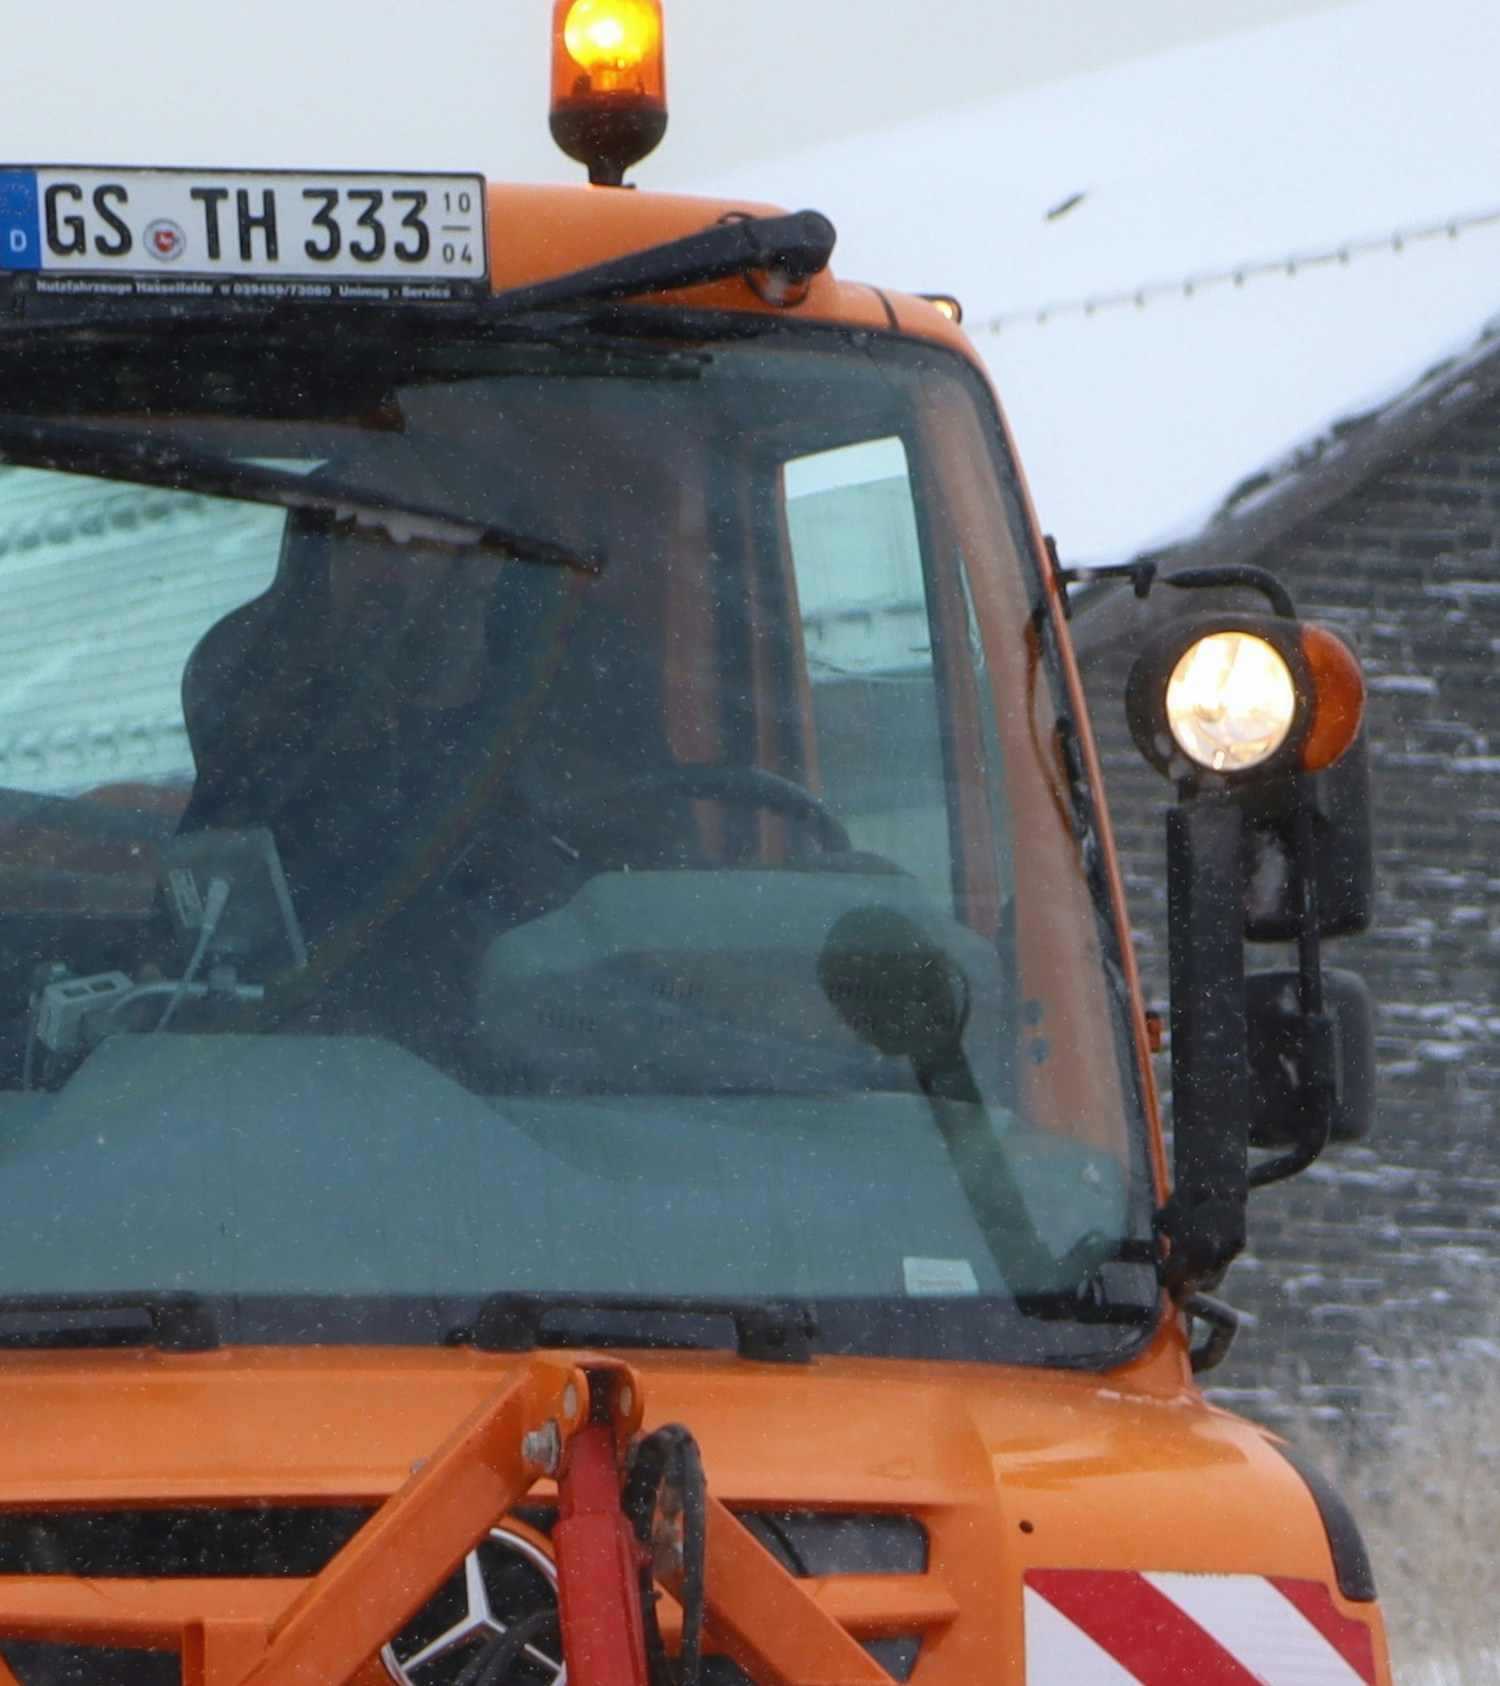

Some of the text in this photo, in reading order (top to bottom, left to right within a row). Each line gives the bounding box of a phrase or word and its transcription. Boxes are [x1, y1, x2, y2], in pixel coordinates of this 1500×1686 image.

[443, 191, 471, 213] 10
[44, 183, 430, 263] GS TH 333
[10, 229, 27, 251] D
[442, 242, 473, 264] 04
[338, 285, 390, 300] Unimog
[401, 286, 452, 299] Service
